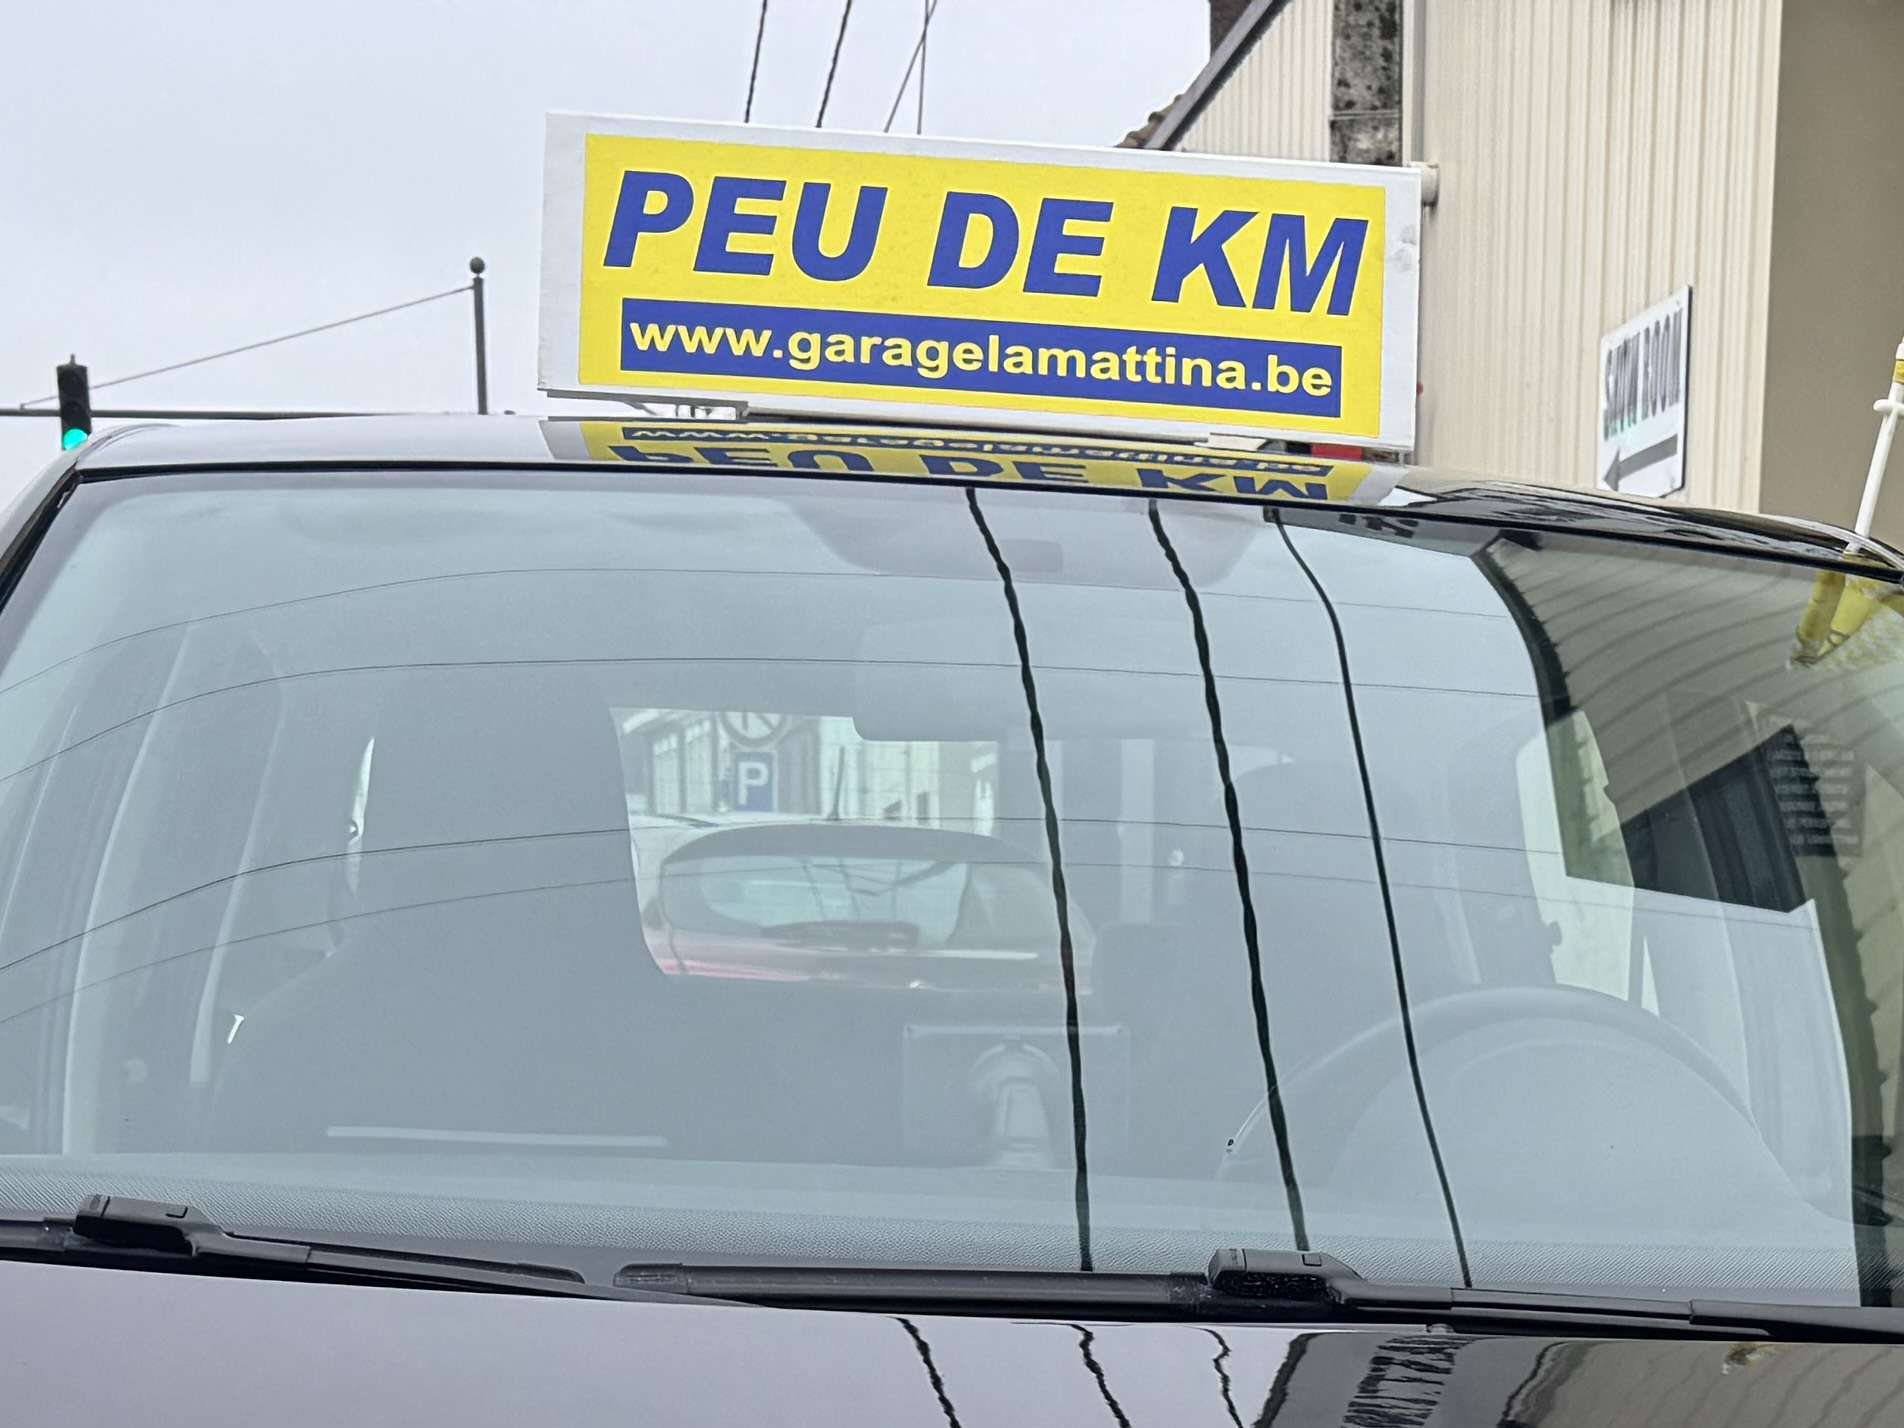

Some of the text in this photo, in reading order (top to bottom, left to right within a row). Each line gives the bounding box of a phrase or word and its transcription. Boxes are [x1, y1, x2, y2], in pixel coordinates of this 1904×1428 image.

[603, 169, 1369, 317] PEU DE KM
[629, 321, 1334, 397] www.garagelamattina.be
[738, 761, 768, 805] P
